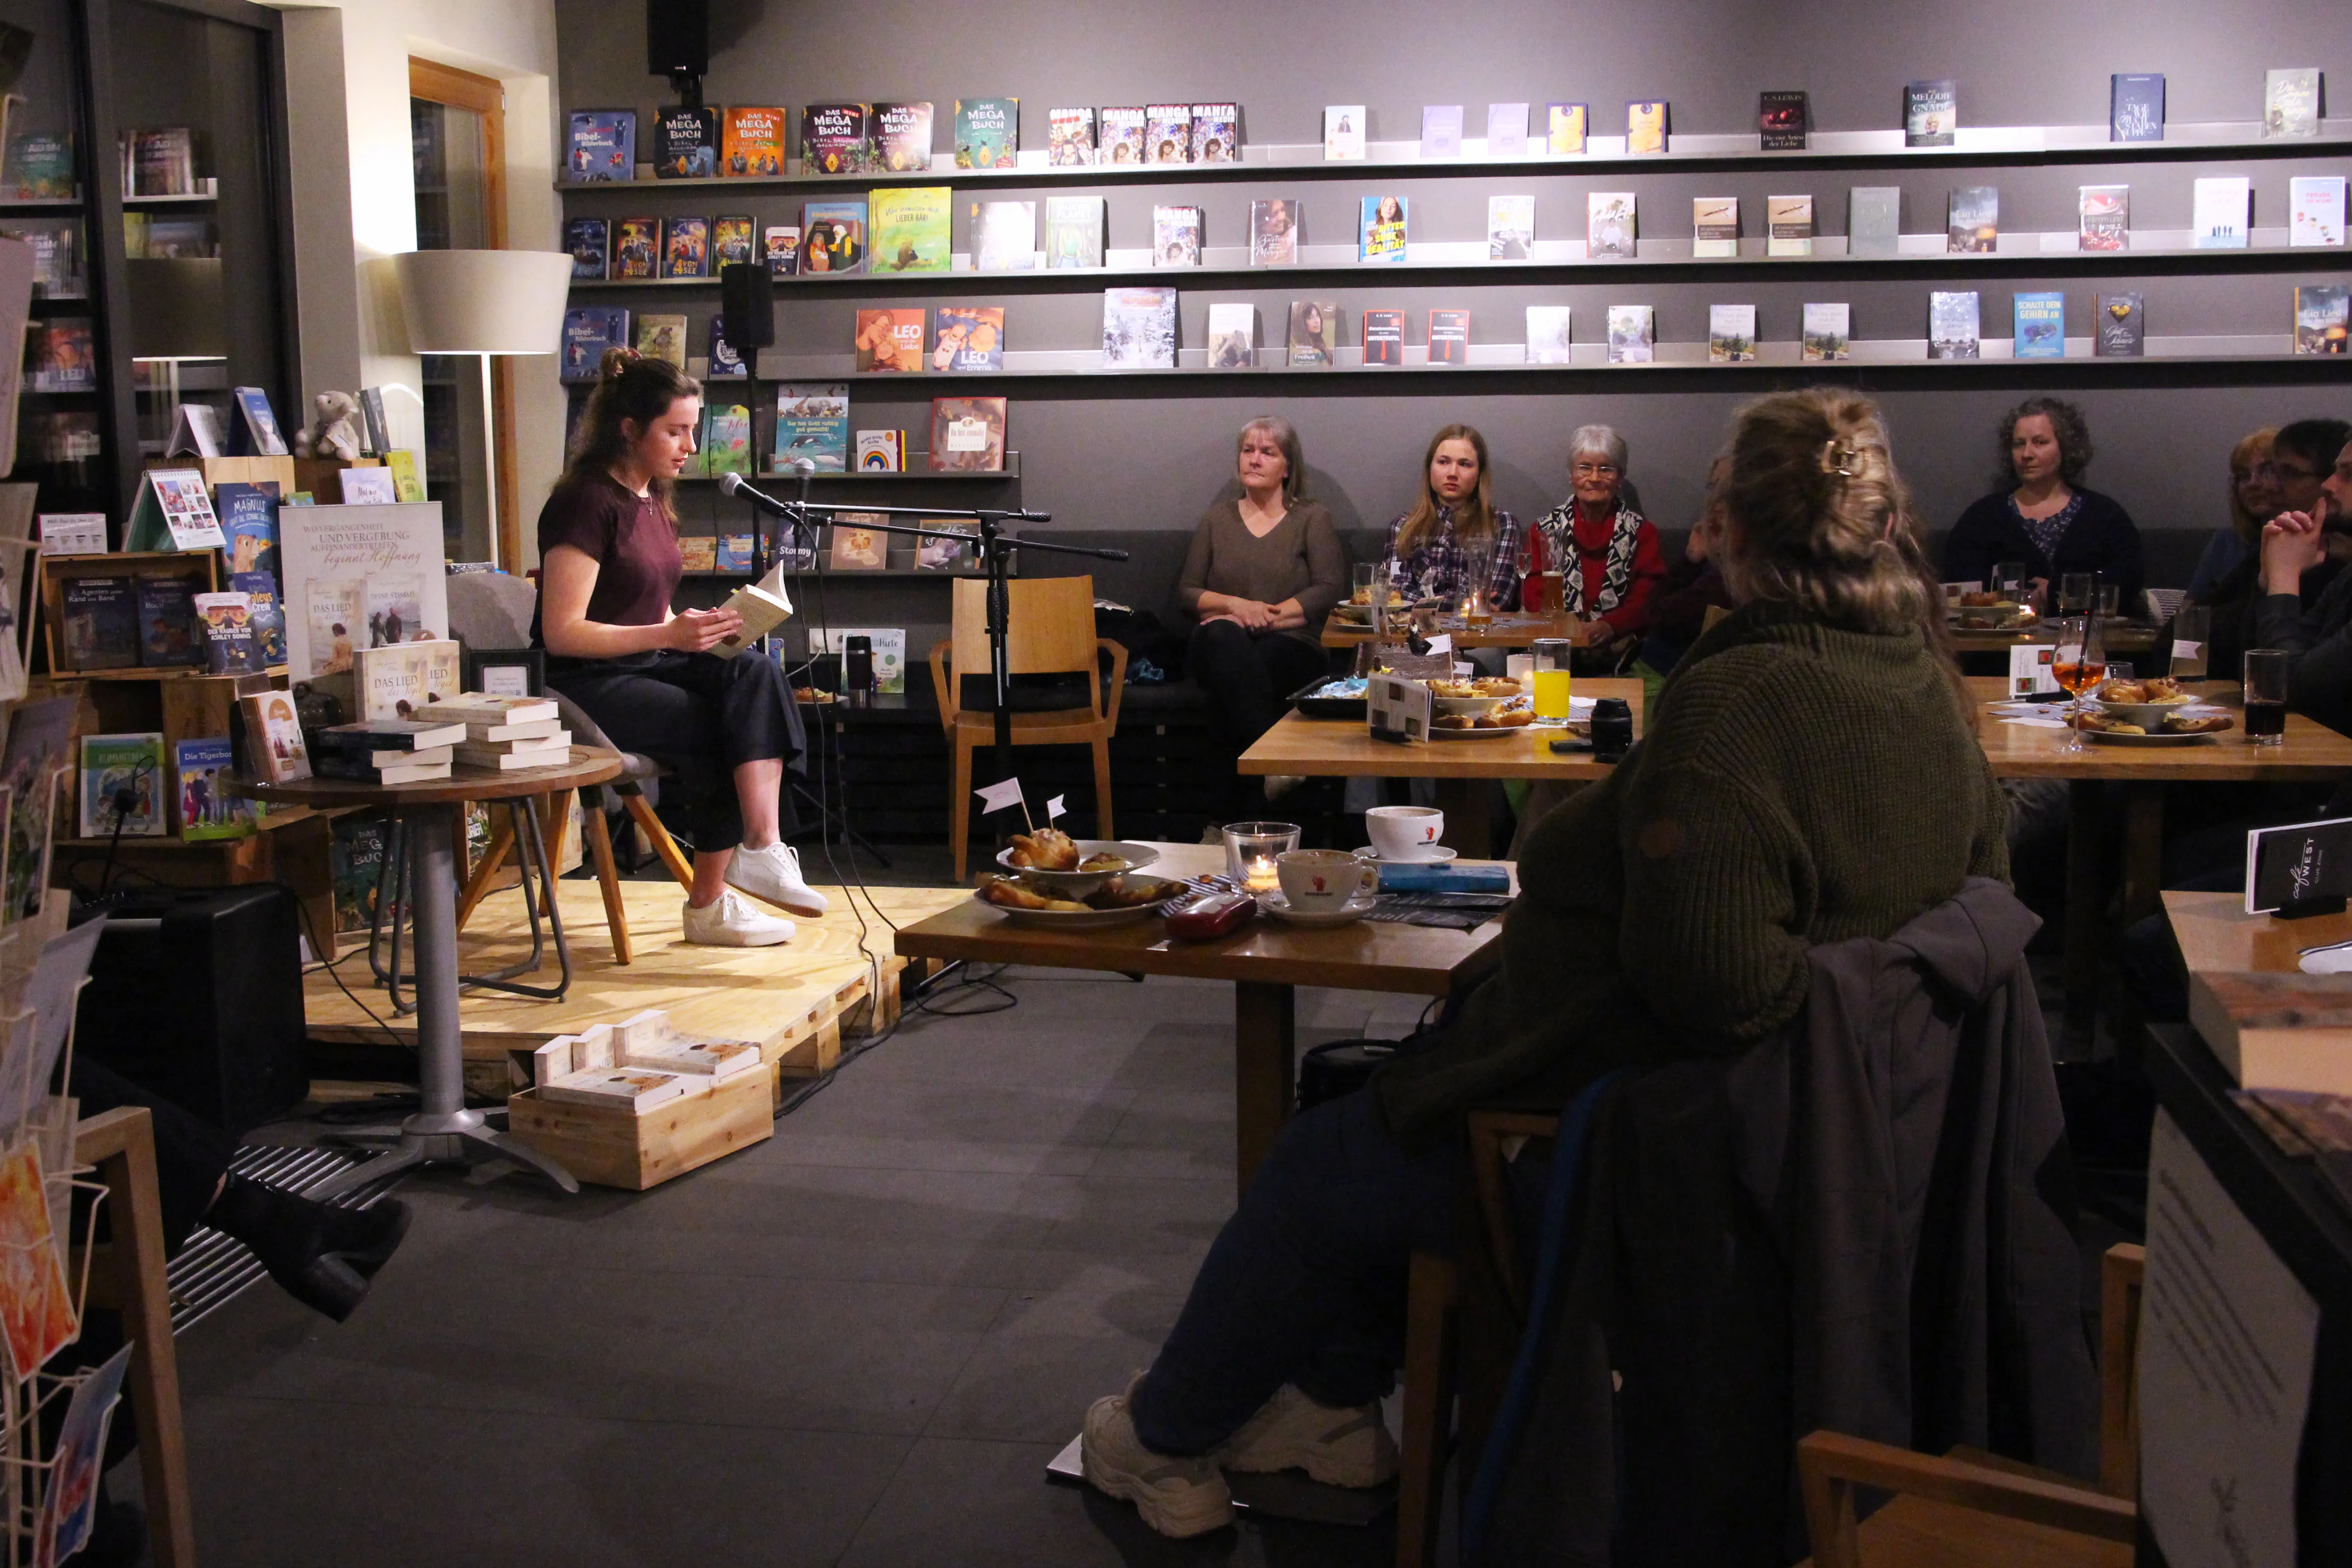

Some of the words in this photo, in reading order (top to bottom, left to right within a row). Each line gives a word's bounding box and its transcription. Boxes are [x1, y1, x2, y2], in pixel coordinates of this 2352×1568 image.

[1912, 92, 1952, 101] MELODIE
[967, 110, 1005, 120] MEGA
[1049, 108, 1093, 120] MANGA
[1102, 110, 1144, 122] MANGA
[1146, 106, 1190, 118] MANGA
[736, 119, 774, 129] MEGA
[814, 115, 852, 126] MEGA
[880, 114, 918, 124] MEGA
[666, 120, 702, 129] MEGA
[884, 124, 917, 133] BUCH
[972, 121, 1004, 130] BUCH
[670, 130, 702, 139] BUCH
[740, 129, 773, 138] BUCH
[818, 126, 851, 135] BUCH
[575, 132, 601, 141] Bibel-
[896, 214, 915, 223] LIEBER
[1154, 208, 1198, 221] MANGA
[1366, 240, 1405, 256] REALITÄT
[624, 260, 633, 276] 4
[673, 258, 684, 275] 4
[2018, 301, 2045, 309] SCHALTE
[2046, 301, 2061, 309] DEIN
[2020, 310, 2049, 320] GEHIRN
[2050, 311, 2059, 319] AN
[568, 327, 594, 336] Bibel-
[894, 325, 921, 339] LEO
[961, 351, 989, 364] LEO
[234, 498, 266, 514] MAGNUS
[319, 523, 384, 532] VERGANGENHEIT
[320, 534, 344, 544] UND
[346, 531, 410, 541] VERGEBUNG
[780, 545, 812, 557] Stormy
[324, 550, 365, 572] beginnt
[369, 546, 421, 571] Hoffnung
[252, 603, 271, 612] Crew
[313, 604, 329, 613] DAS
[331, 603, 351, 612] LIED
[879, 638, 899, 647] Hirte
[374, 678, 393, 689] DAS
[396, 675, 418, 686] LIED
[359, 830, 377, 838] DAS
[347, 838, 384, 853] MEG
[353, 853, 393, 865] BUC
[2301, 838, 2315, 877] WEST
[2290, 864, 2310, 899] café
